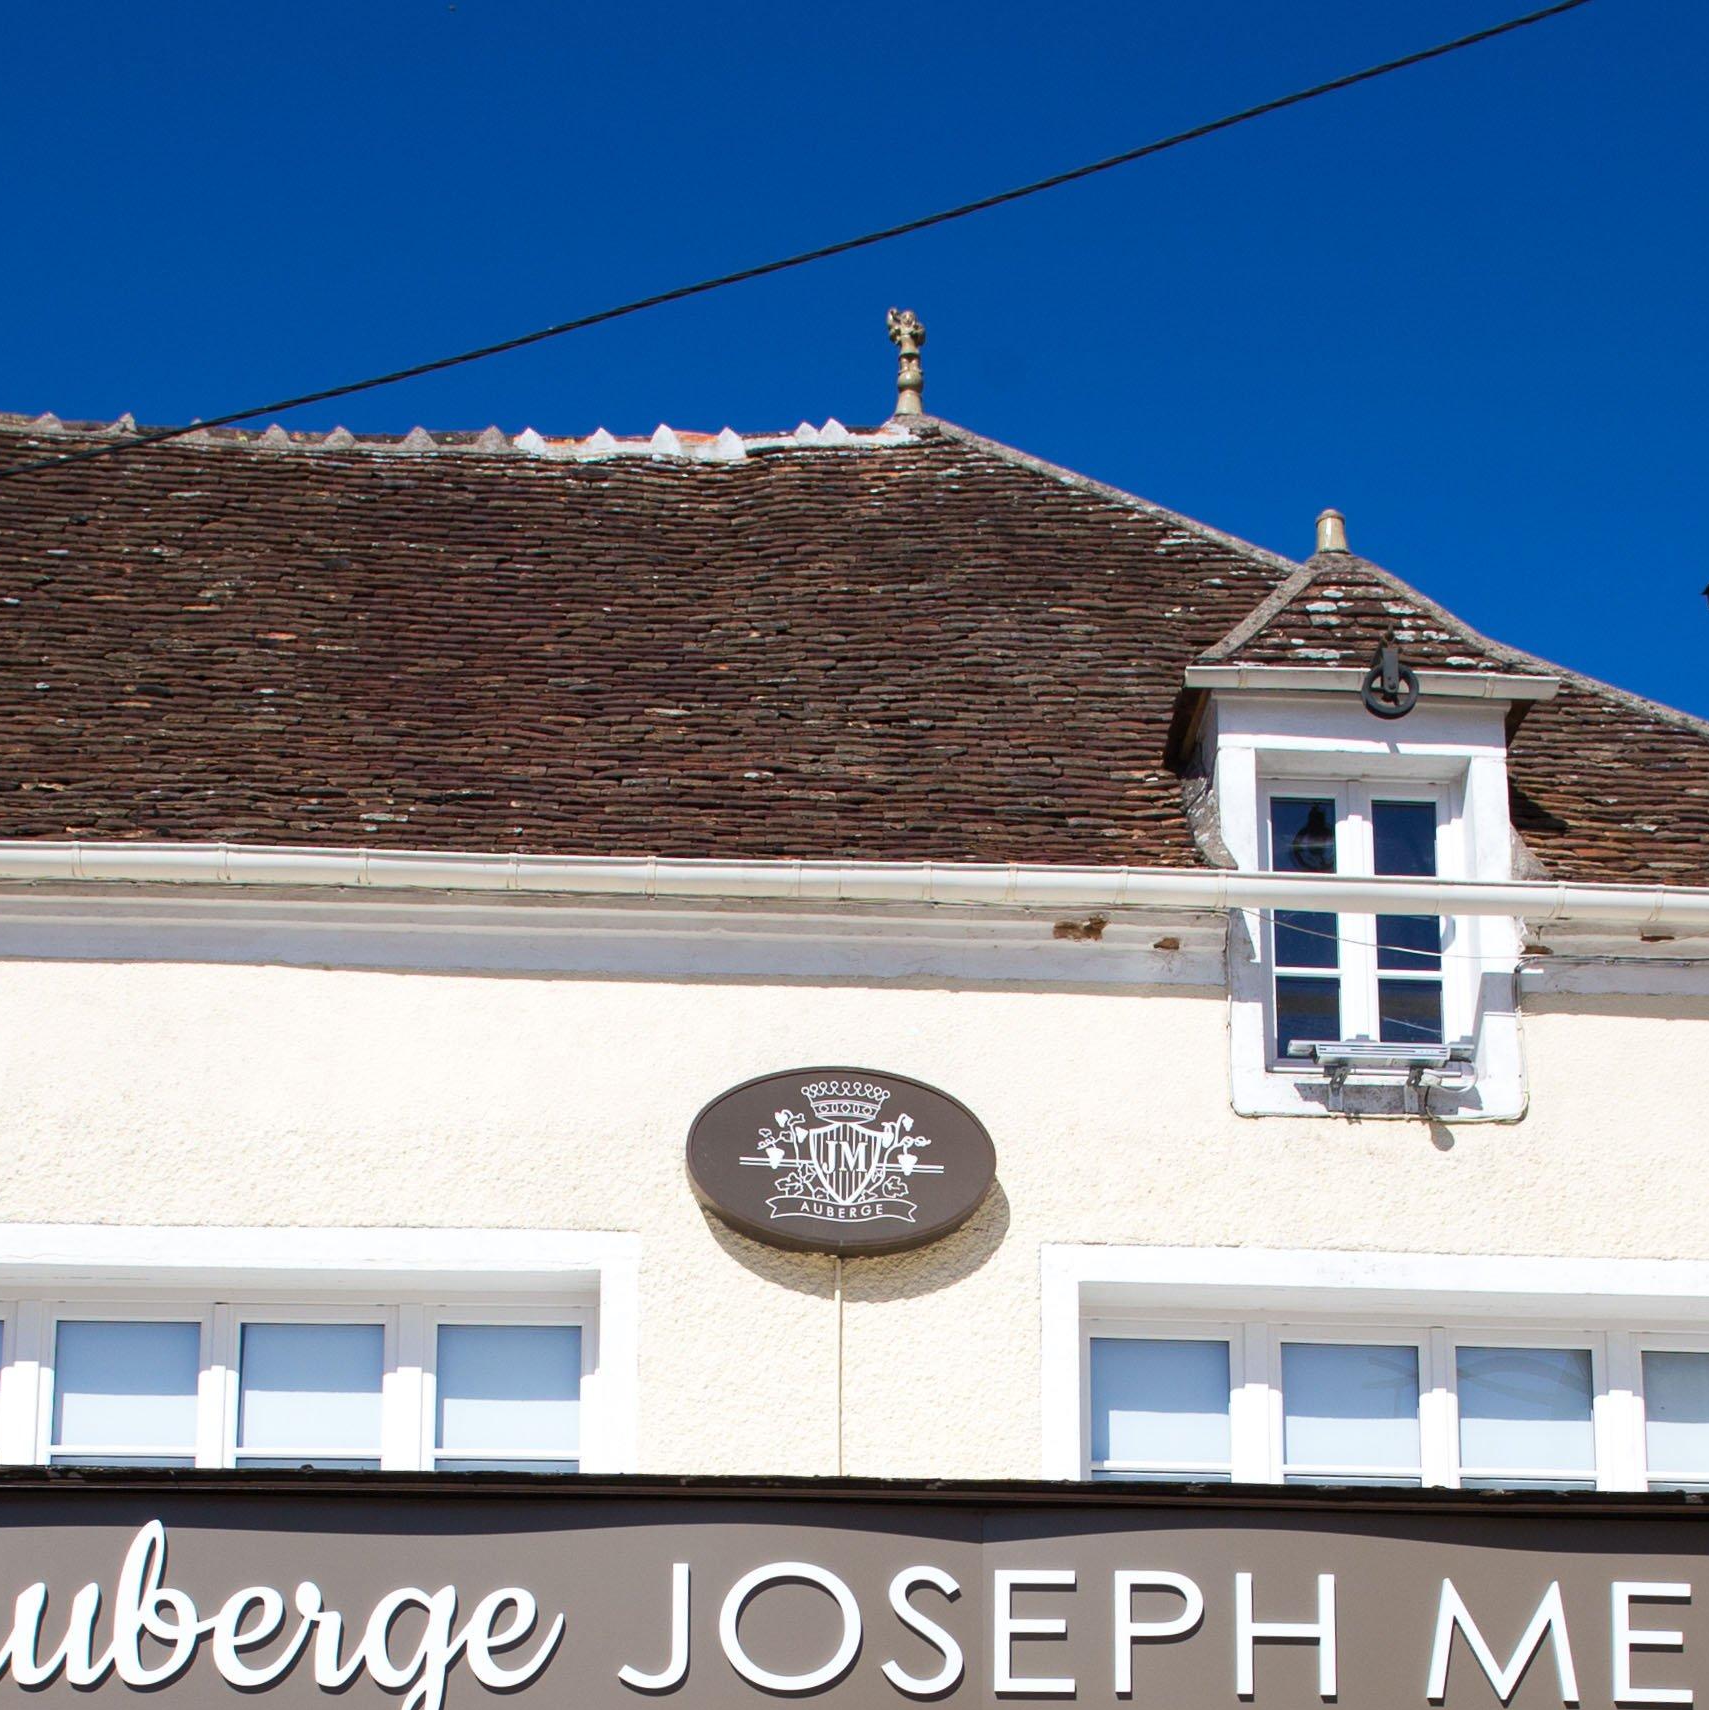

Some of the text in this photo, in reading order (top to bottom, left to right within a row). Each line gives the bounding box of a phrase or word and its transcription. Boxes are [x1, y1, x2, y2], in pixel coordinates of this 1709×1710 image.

[822, 1140, 868, 1174] JM
[800, 1201, 884, 1218] AUBERGE
[617, 1561, 1338, 1696] JOSEPH
